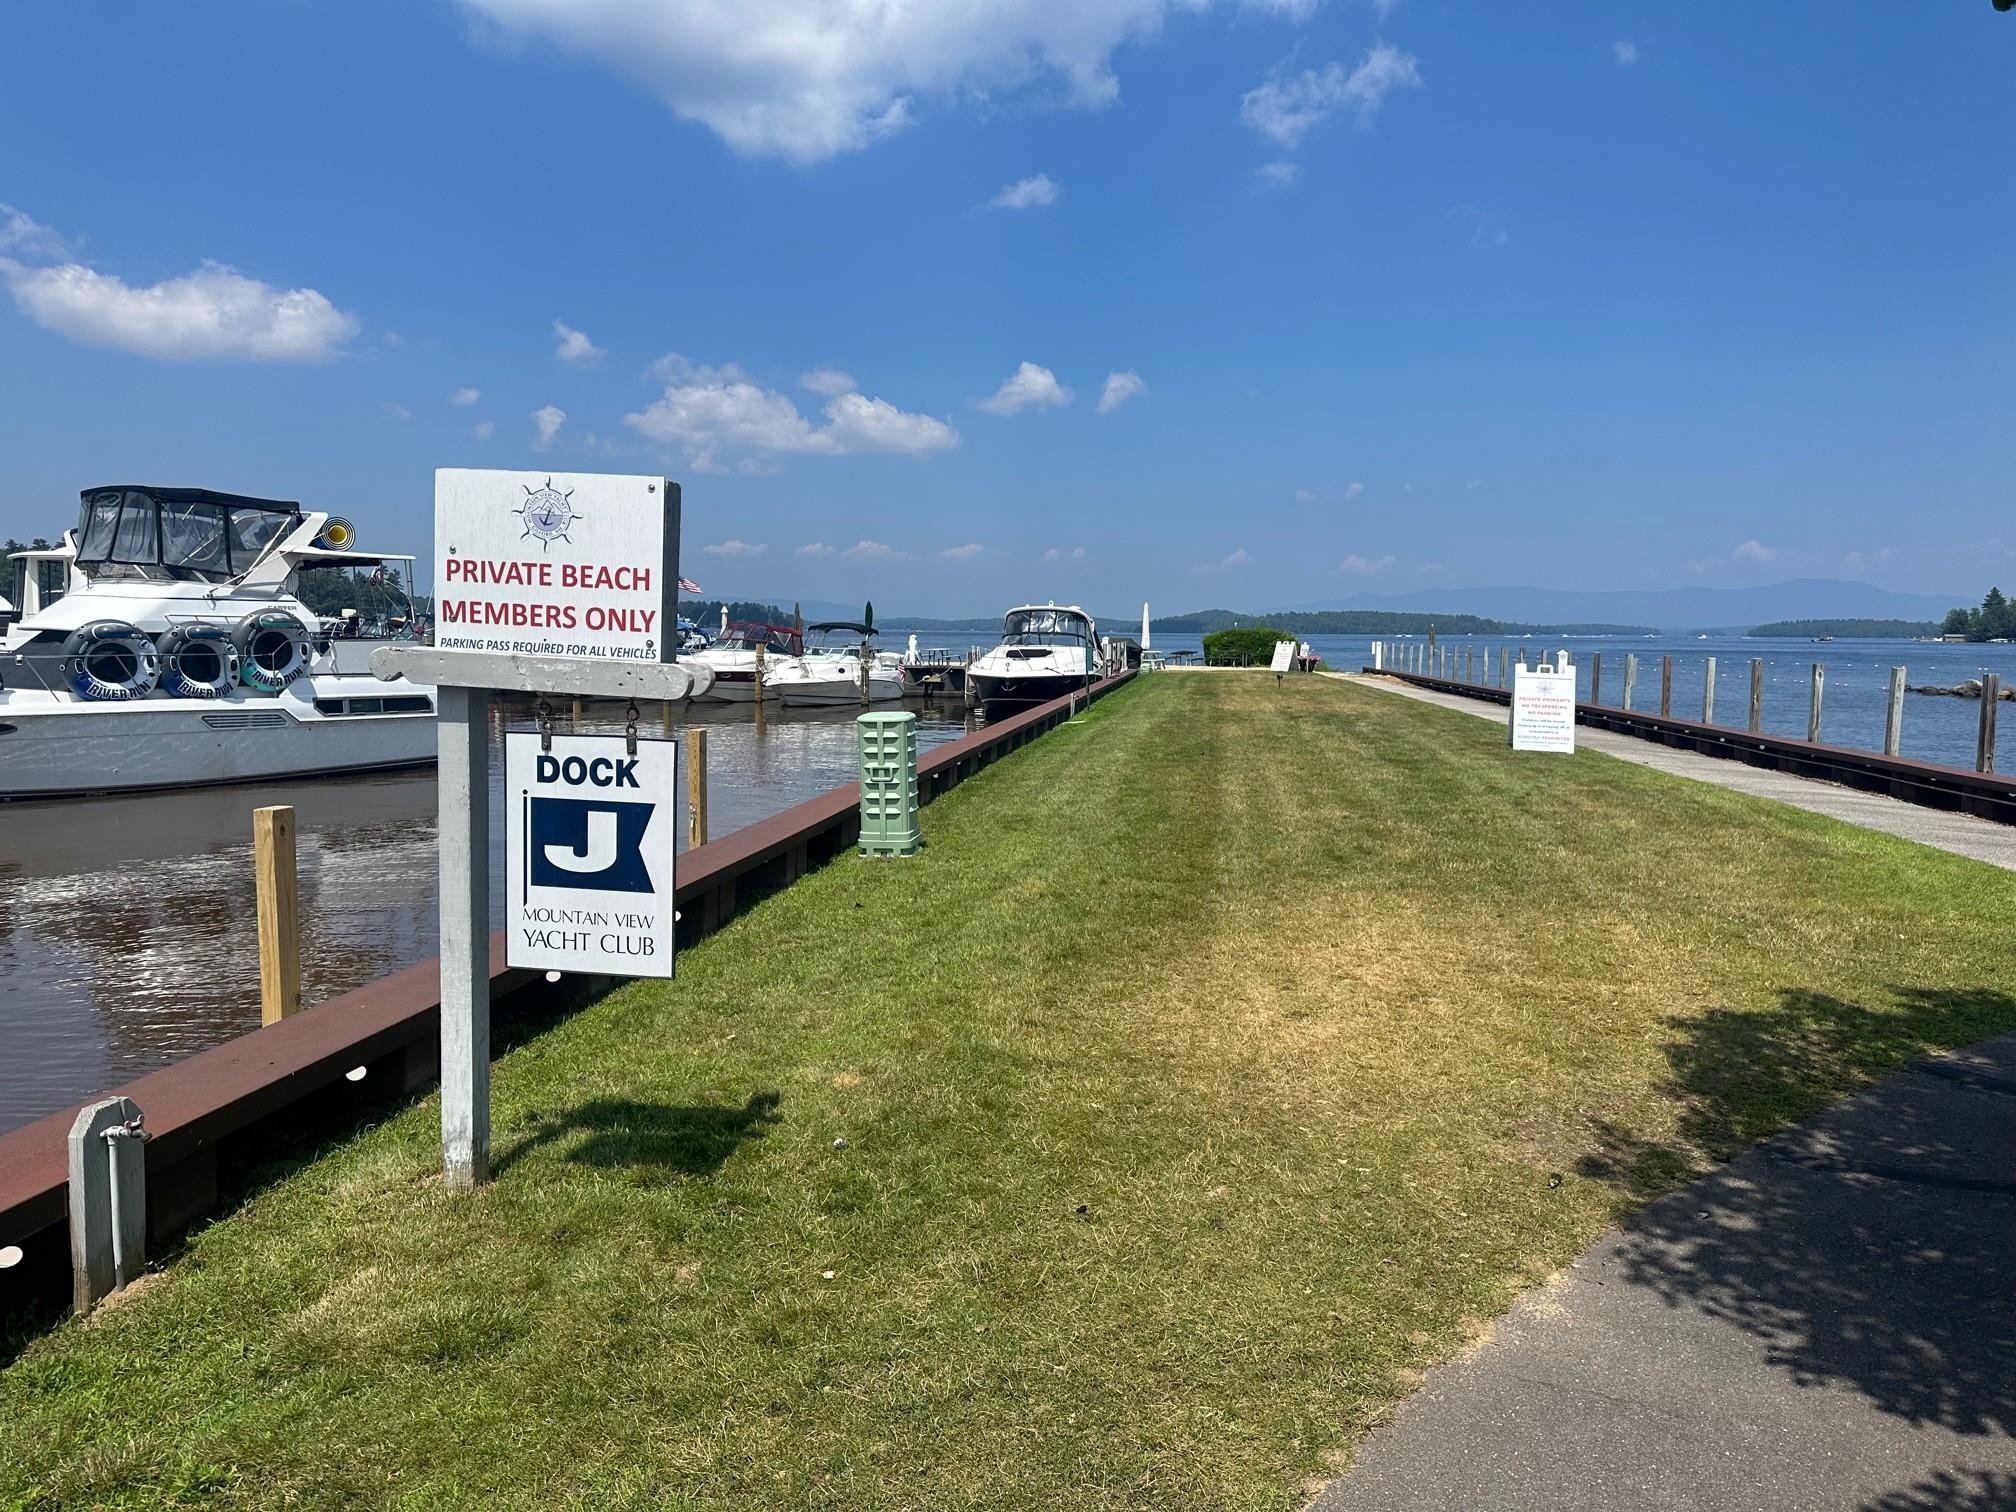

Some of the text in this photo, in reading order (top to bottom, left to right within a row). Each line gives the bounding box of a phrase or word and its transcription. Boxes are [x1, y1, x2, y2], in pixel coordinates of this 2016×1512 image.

[446, 559, 650, 591] PRIVATE BEACH
[442, 600, 656, 633] MEMBERS ONLY
[440, 638, 656, 659] PARKING PASS REQUIRED FOR ALL VEHICLES
[252, 665, 303, 687] RIVER RUN
[87, 682, 128, 699] RIVER
[129, 680, 151, 698] RUN
[178, 681, 234, 697] RIVER RUN
[537, 755, 640, 788] DOCK
[544, 811, 617, 873] J
[522, 908, 654, 929] MOUNTAIN VIEW
[523, 928, 655, 956] YACHT CLUB
